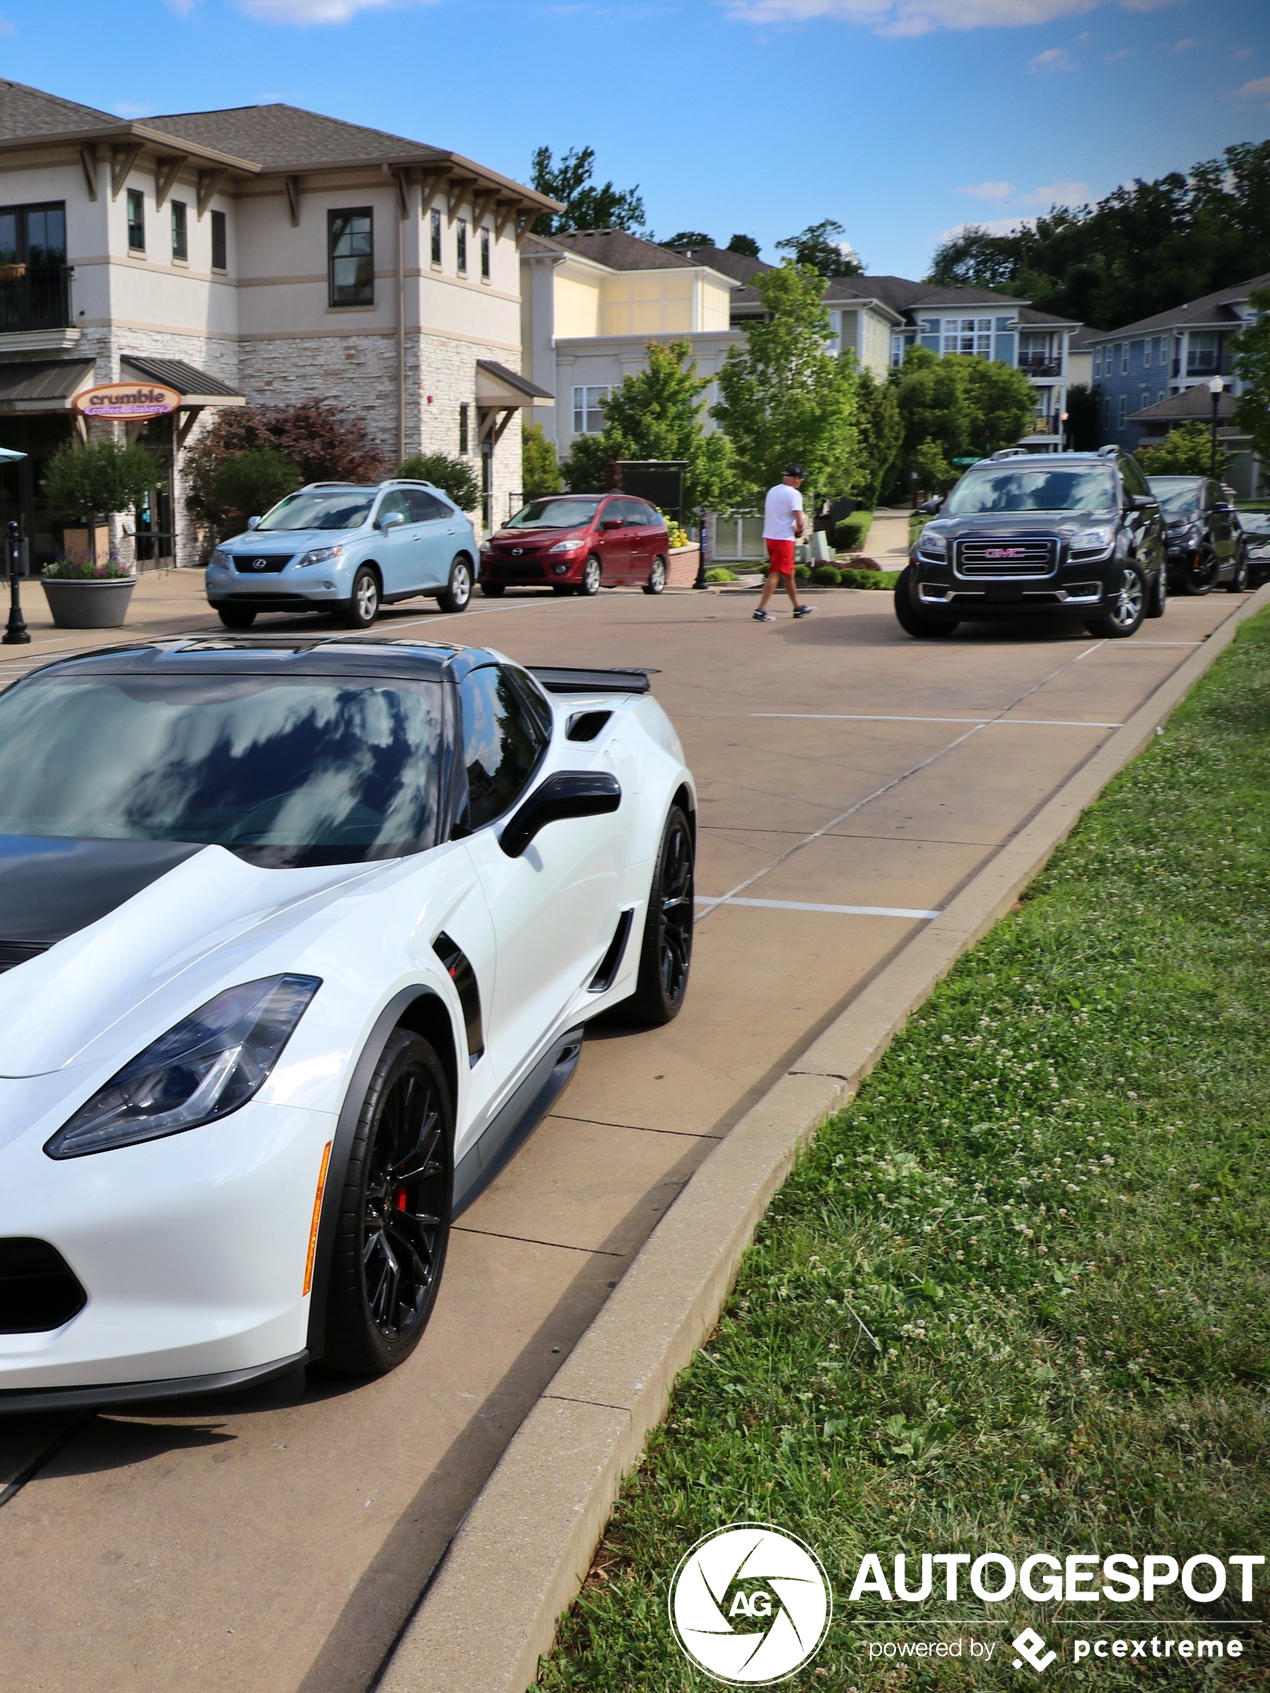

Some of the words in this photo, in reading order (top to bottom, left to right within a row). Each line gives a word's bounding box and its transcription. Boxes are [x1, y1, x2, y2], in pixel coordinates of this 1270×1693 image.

[90, 389, 165, 405] crumble
[134, 405, 165, 414] bakery
[985, 548, 1026, 559] GMC
